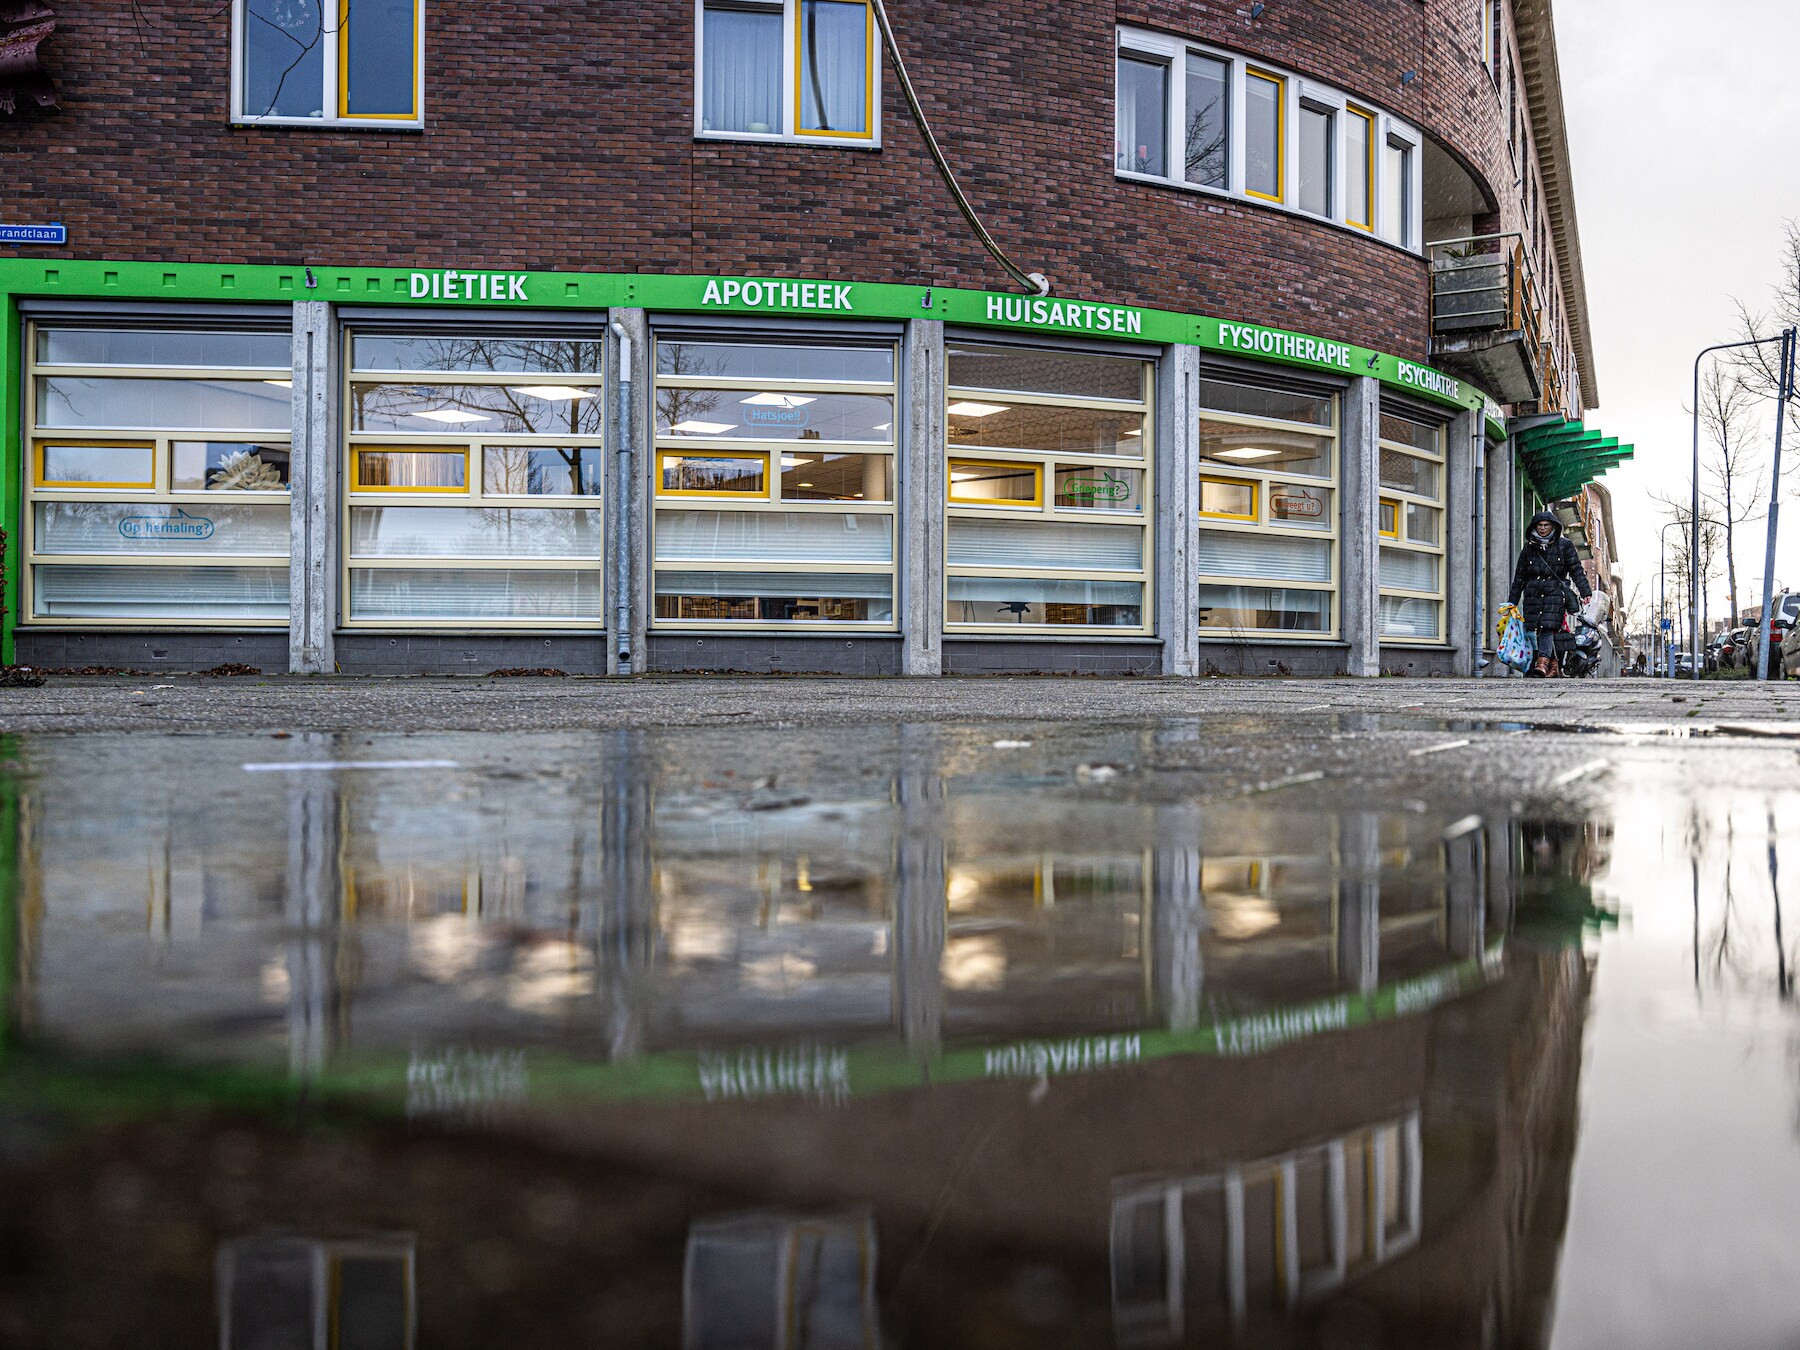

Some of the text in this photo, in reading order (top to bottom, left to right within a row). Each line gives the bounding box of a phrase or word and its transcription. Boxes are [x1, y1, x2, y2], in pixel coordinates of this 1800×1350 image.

[0, 229, 57, 239] randtlaan
[410, 270, 529, 300] DIËTIEK
[701, 280, 853, 310] APOTHEEK
[986, 296, 1142, 334] HUISARTSEN
[1218, 323, 1351, 368] FYSIOTHERAPIE
[1398, 361, 1460, 399] PSYCHIATRIE
[752, 409, 801, 423] Hatsjoe!!
[1071, 483, 1121, 497] Grieperig?
[1276, 499, 1315, 512] weegt u?
[123, 522, 210, 536] Op herhaling?
